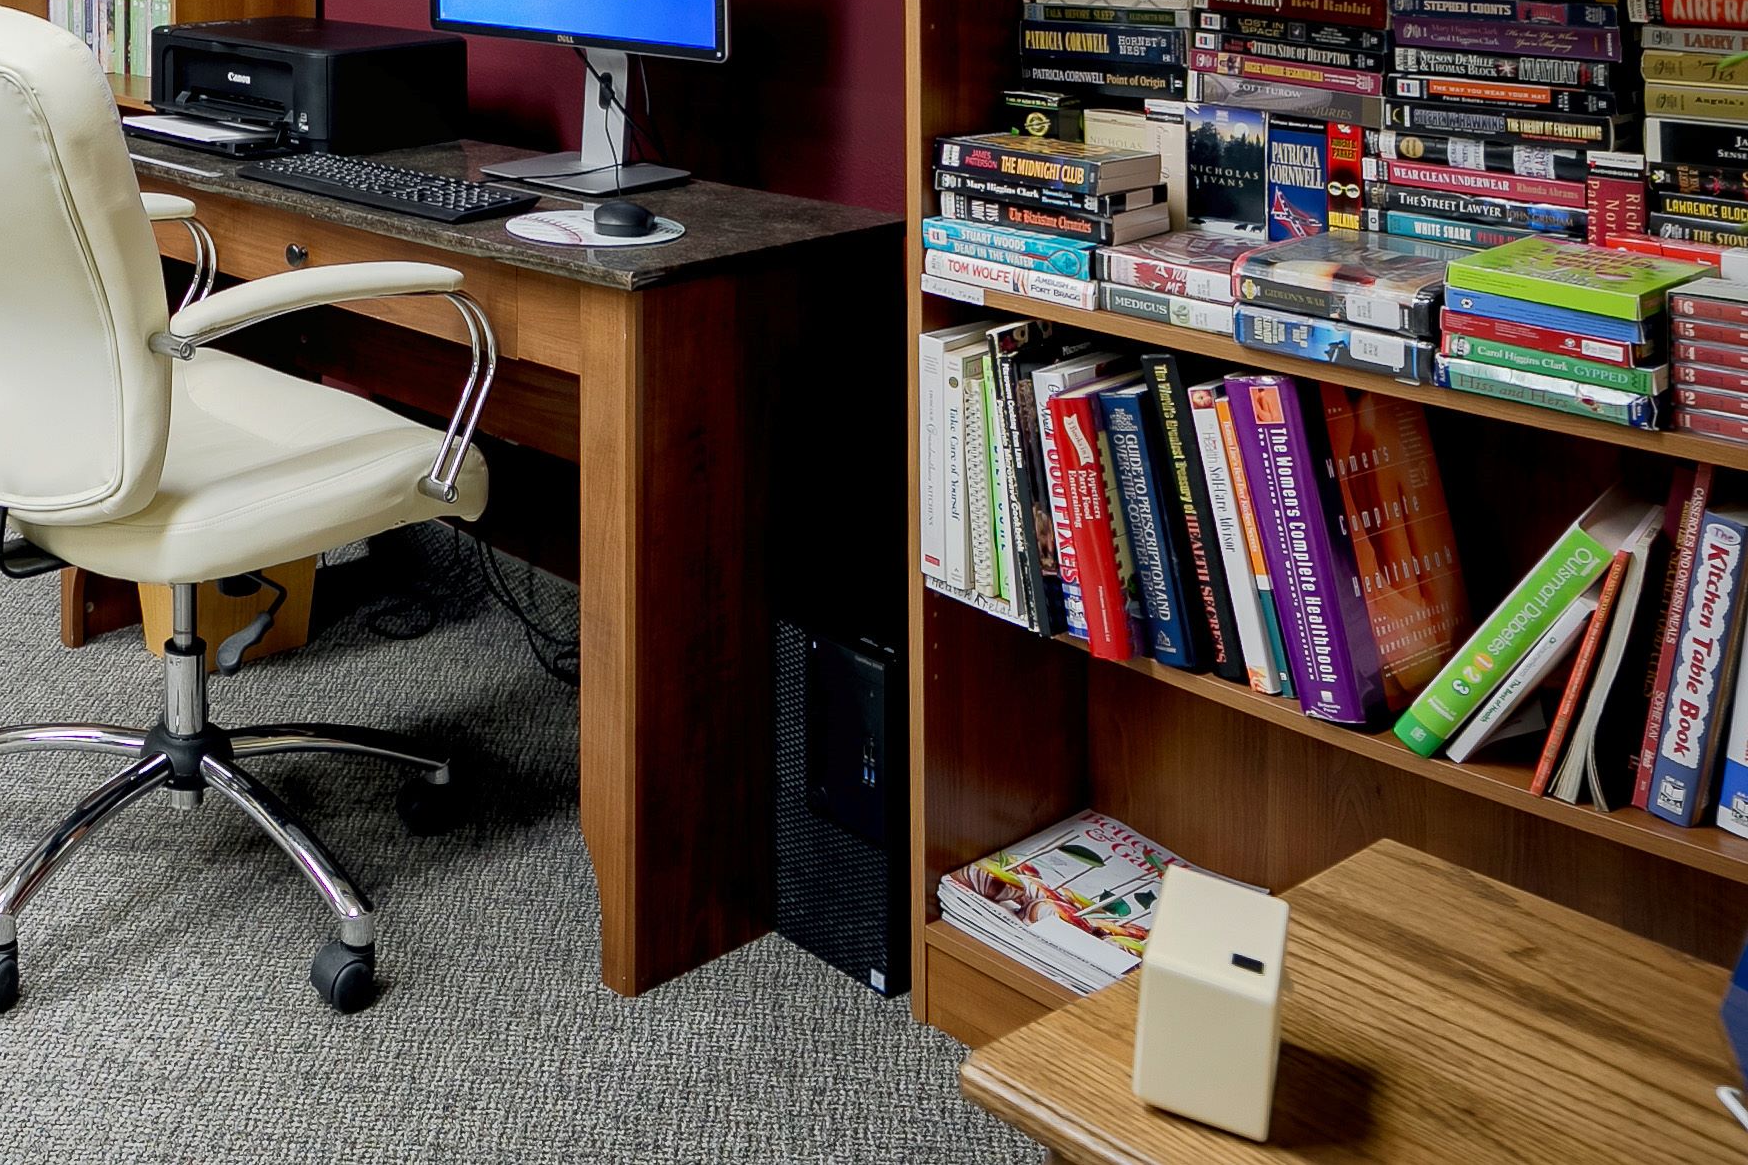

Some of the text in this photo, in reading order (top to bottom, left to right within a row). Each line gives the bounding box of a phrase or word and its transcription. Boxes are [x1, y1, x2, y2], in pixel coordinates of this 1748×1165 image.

[1423, 0, 1512, 16] STEPHEN COONTS
[1237, 18, 1285, 30] LOST IN
[557, 34, 574, 43] DELL
[1025, 30, 1109, 54] PATRICIA CORNWELL
[1119, 47, 1147, 56] NEST
[1683, 33, 1735, 50] LARRY
[1251, 39, 1352, 67] OTHER SIDE OF DECEPTION
[227, 71, 251, 85] Canon
[1032, 68, 1166, 89] PATRICIA CORNWELL Point of Origin
[1467, 64, 1498, 77] BLOCK
[1518, 57, 1580, 84] MAYDAY
[1271, 141, 1321, 168] PATRICIA
[1001, 156, 1085, 185] THE MIDNIGHT CLUB
[1190, 163, 1260, 180] NICHOLAS
[1203, 174, 1245, 188] EVANS
[1269, 163, 1325, 190] CORNWELL
[1393, 167, 1579, 200] WEAR CLEAN UNDERWEAR Rhonda Abrams
[966, 177, 1040, 199] Mary Higgins Clark
[1398, 192, 1420, 207] THE
[1420, 195, 1457, 211] STREET
[1459, 200, 1502, 218] LAWYER
[1531, 212, 1574, 228] GRISHAM
[1414, 221, 1472, 242] WHITE SHARK
[947, 258, 1012, 285] TOM WOLFE
[1030, 284, 1082, 303] FORT BRAGG
[1113, 295, 1168, 315] MEDICUS
[1477, 345, 1629, 385] Carol Higgins Clark GYPPED
[1326, 446, 1391, 480] Women's
[1067, 470, 1084, 529] Entertaining
[1077, 469, 1094, 521] Party Food
[1087, 469, 1103, 520] Appetizers
[1210, 466, 1237, 554] Self-Care Advisor
[1338, 495, 1422, 536] Complete
[1125, 433, 1171, 622] GUIDE TO PRESCRIPTION AND
[1711, 526, 1736, 544] The
[1269, 427, 1338, 682] The Women's Complete Healthbook
[1665, 486, 1706, 645] CASSEROLES AND ONE-DISH MEALS
[1352, 545, 1454, 598] Healthbook
[1452, 547, 1594, 696] Outsmart Diabetes 1 2 3
[1673, 636, 1714, 758] Table Book
[1647, 689, 1667, 742] SOPHIE KAY
[1078, 813, 1164, 857] Better
